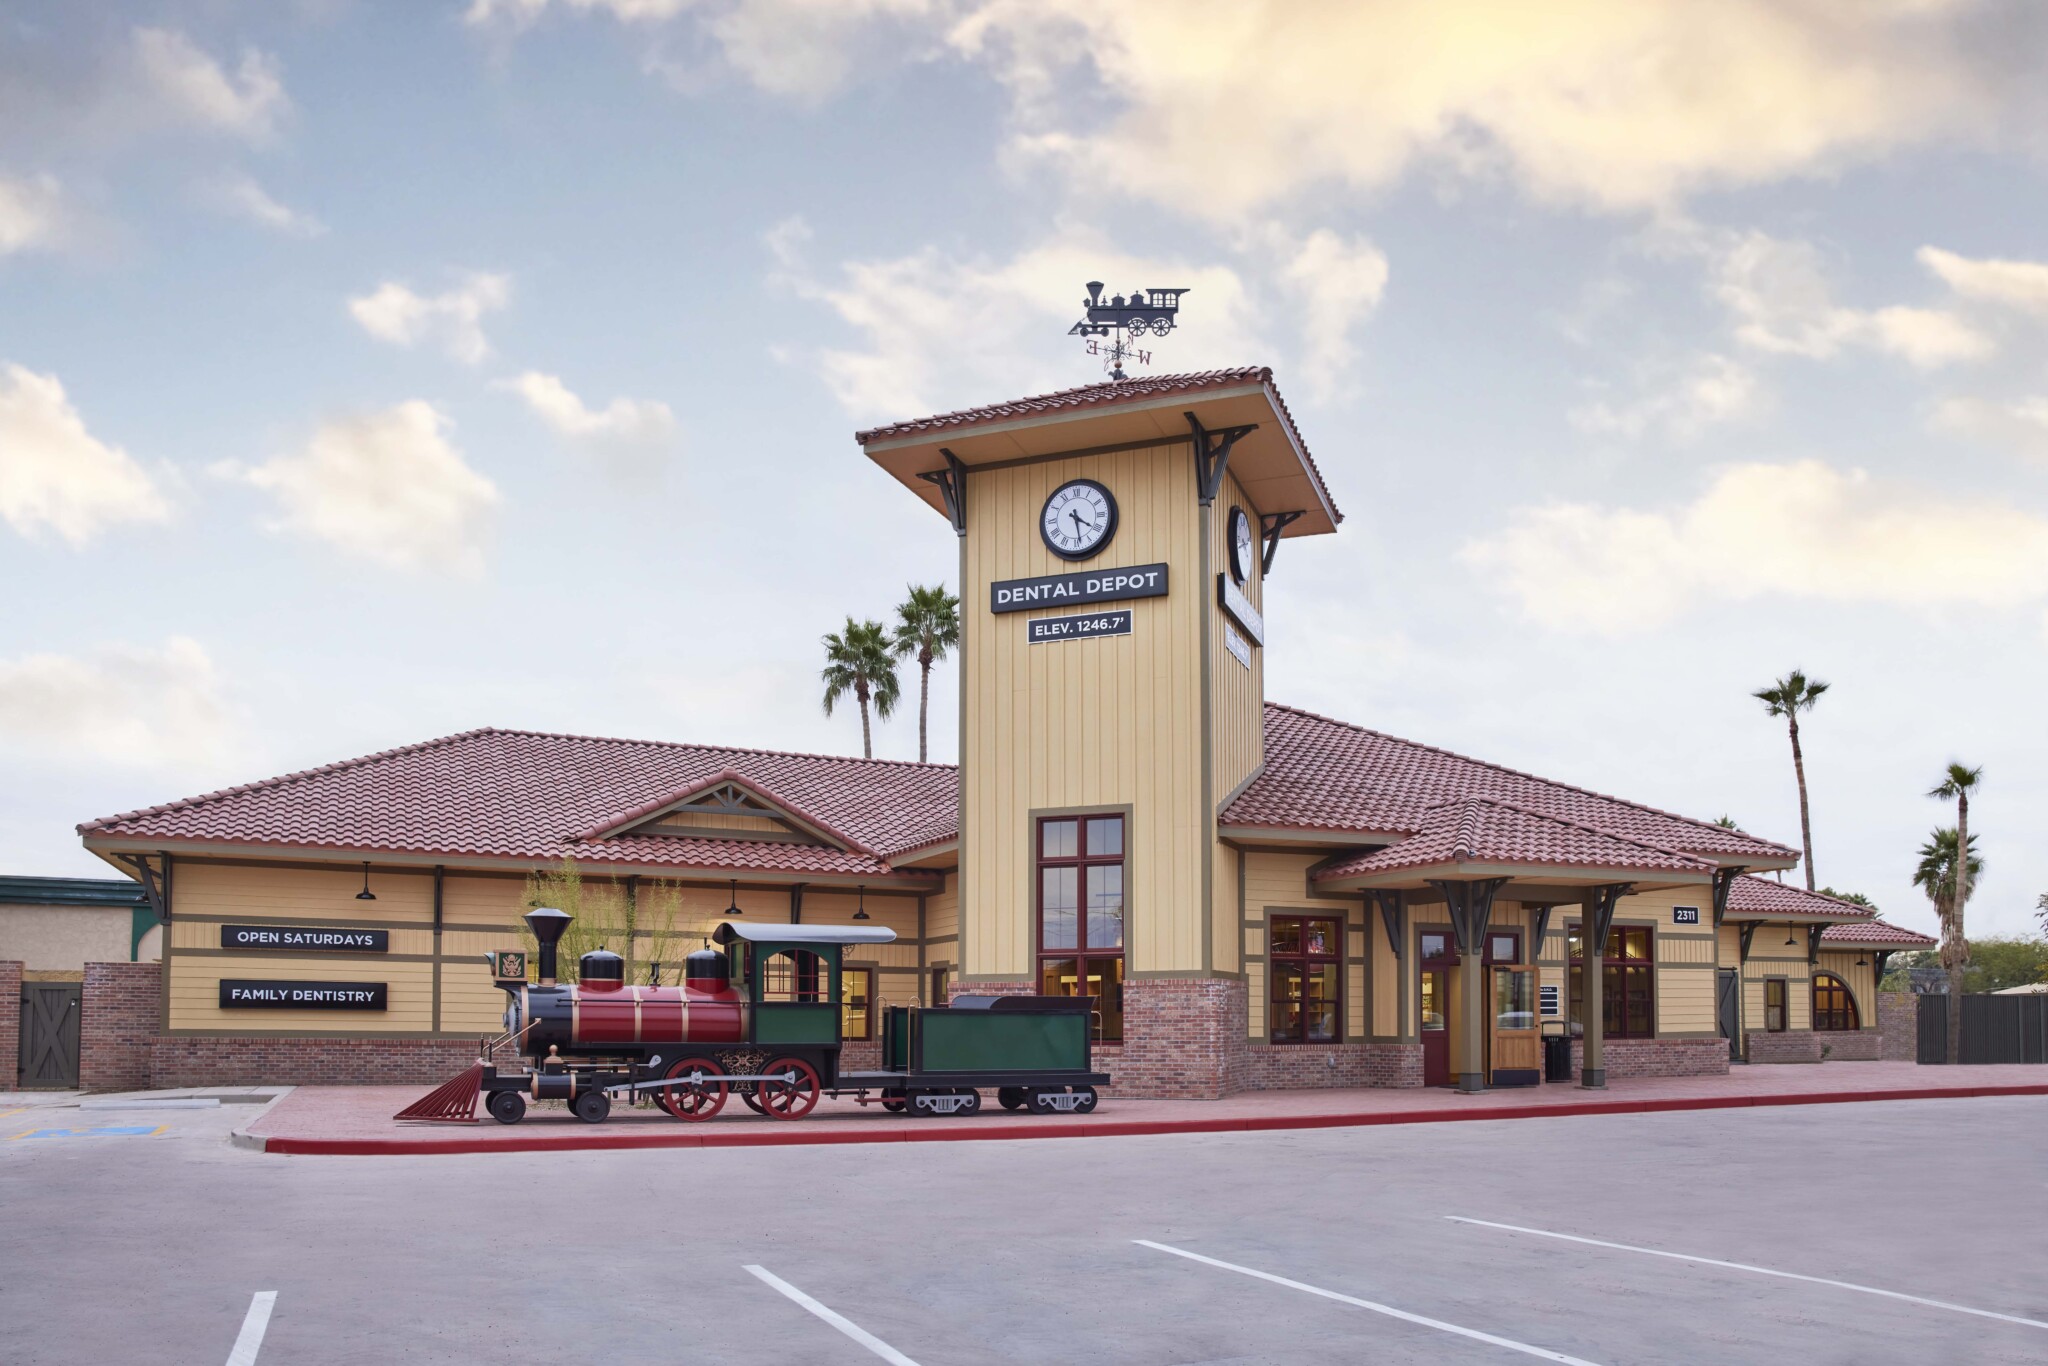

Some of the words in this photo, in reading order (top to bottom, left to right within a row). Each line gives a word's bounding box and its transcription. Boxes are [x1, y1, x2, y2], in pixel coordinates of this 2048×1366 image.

[997, 581, 1080, 604] DENTAL
[1086, 572, 1159, 595] DEPOT
[1035, 622, 1074, 637] ELEV.
[1677, 910, 1695, 920] 2311
[237, 931, 280, 943] OPEN
[283, 932, 374, 946] SATURDAYS
[231, 988, 289, 1001] FAMILY
[292, 989, 375, 1003] DENTISTRY
